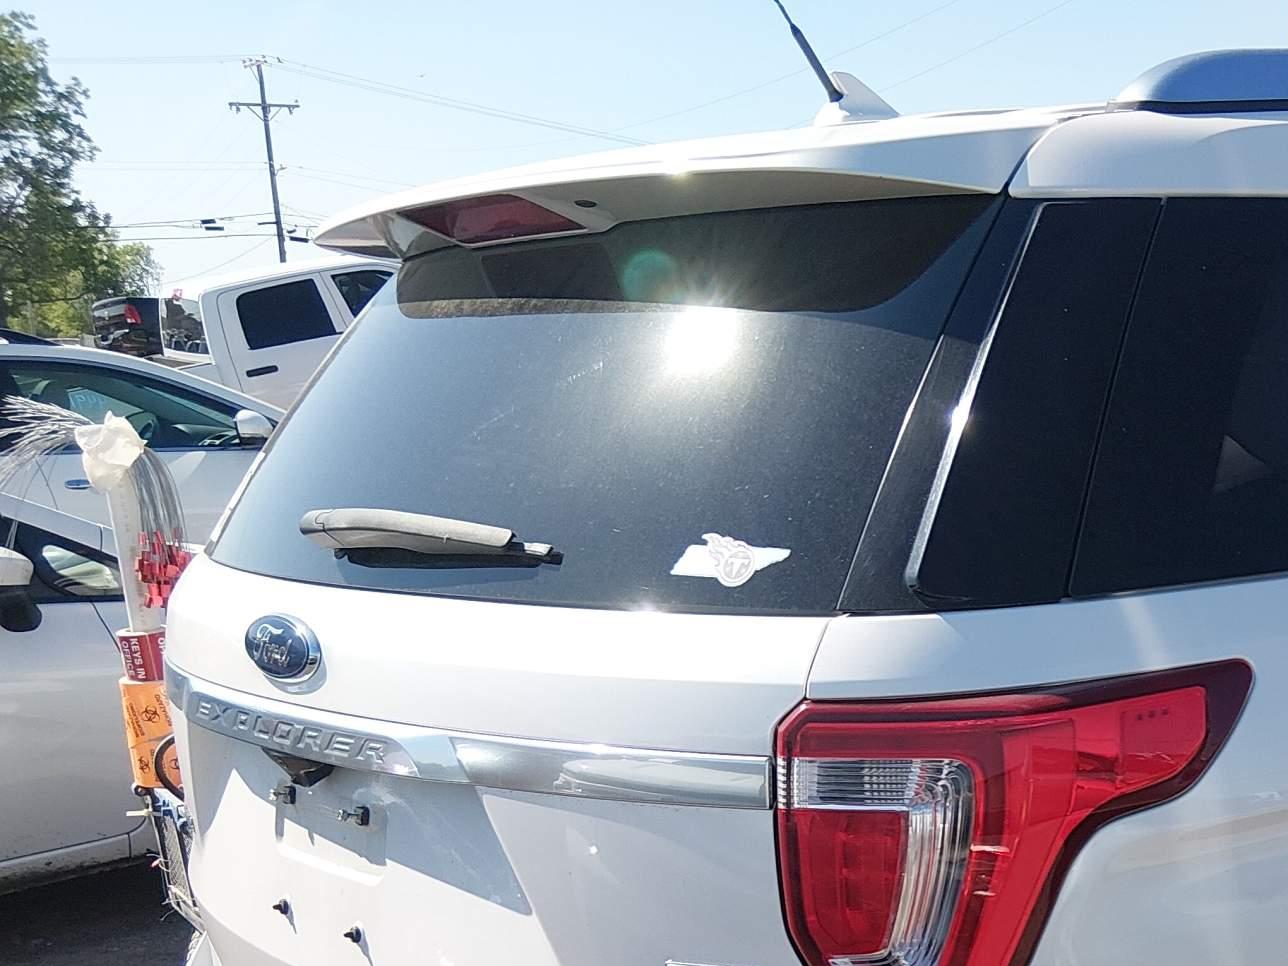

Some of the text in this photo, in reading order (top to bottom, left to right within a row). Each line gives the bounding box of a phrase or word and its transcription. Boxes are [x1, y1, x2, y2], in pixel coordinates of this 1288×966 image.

[121, 640, 135, 677] OFFICE
[129, 637, 146, 680] KEYS IN
[252, 623, 294, 668] Ford
[195, 700, 386, 764] EXPLORER
